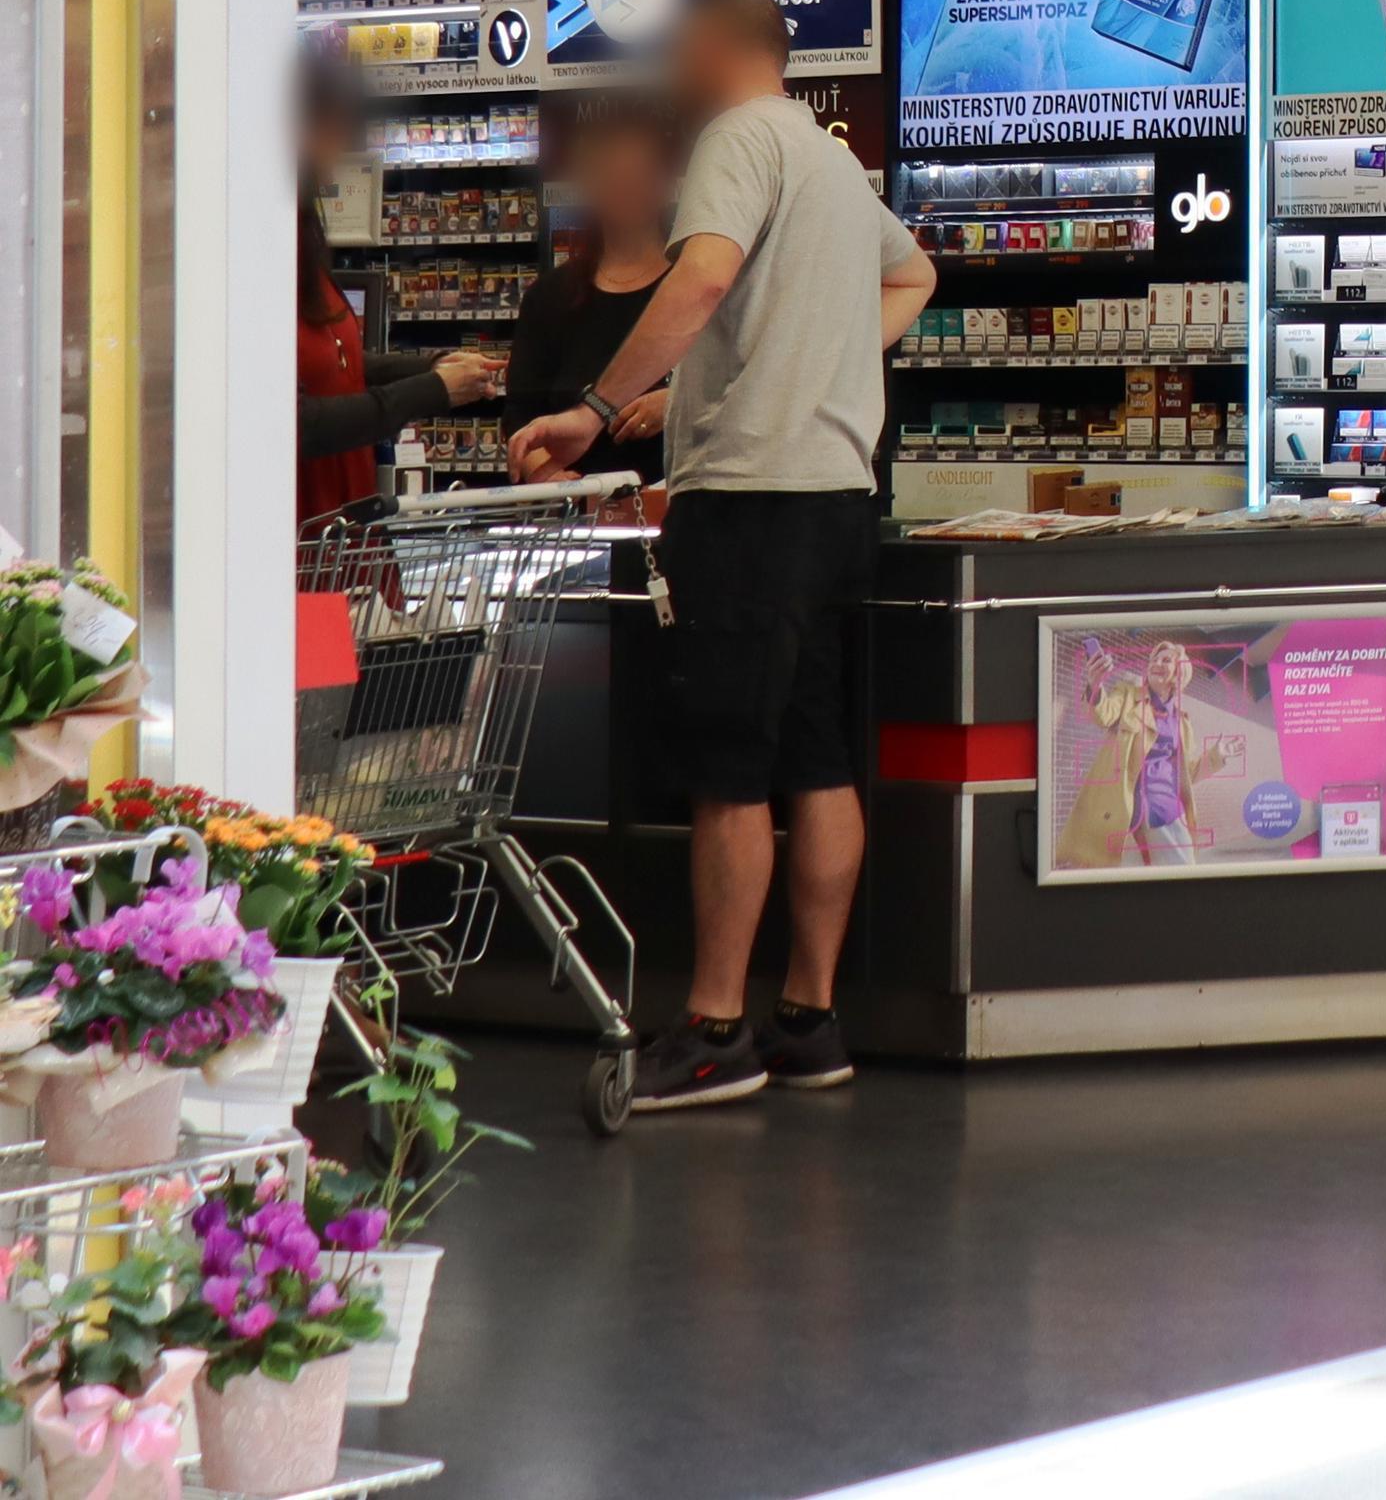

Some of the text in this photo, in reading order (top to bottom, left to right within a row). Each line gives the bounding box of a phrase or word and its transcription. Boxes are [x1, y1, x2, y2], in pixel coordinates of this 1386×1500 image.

[948, 1, 1088, 24] SUPERSLIM TOPAZ
[786, 49, 869, 65] ÁVYKOVOU LÁTKOU
[552, 66, 579, 78] TENTO
[404, 73, 539, 92] je vysoce návykovou látkou.
[902, 86, 1246, 121] MINISTERSTVO ZDRAVOTNICTVÍ VARUJE:
[1273, 97, 1358, 117] MINISTERSTVO
[902, 114, 1246, 148] KOUŘENÍ ZPŮSOBUJE RAKOVINU
[1273, 114, 1336, 138] KOUŘENÍ
[1302, 153, 1309, 164] si
[1310, 155, 1328, 163] svou
[1280, 168, 1318, 179] oblíbenou
[1171, 172, 1232, 235] glo
[1276, 202, 1327, 216] MINISTERSTVO
[1329, 199, 1382, 215] ZDRAVOTNICTVÍ
[926, 469, 994, 485] CANDLELIGHT
[1284, 648, 1335, 664] ODMĚNY
[1335, 649, 1350, 662] ZA
[1284, 663, 1354, 680] ROZTANČÍTE
[1284, 683, 1331, 697] RAZ DVA
